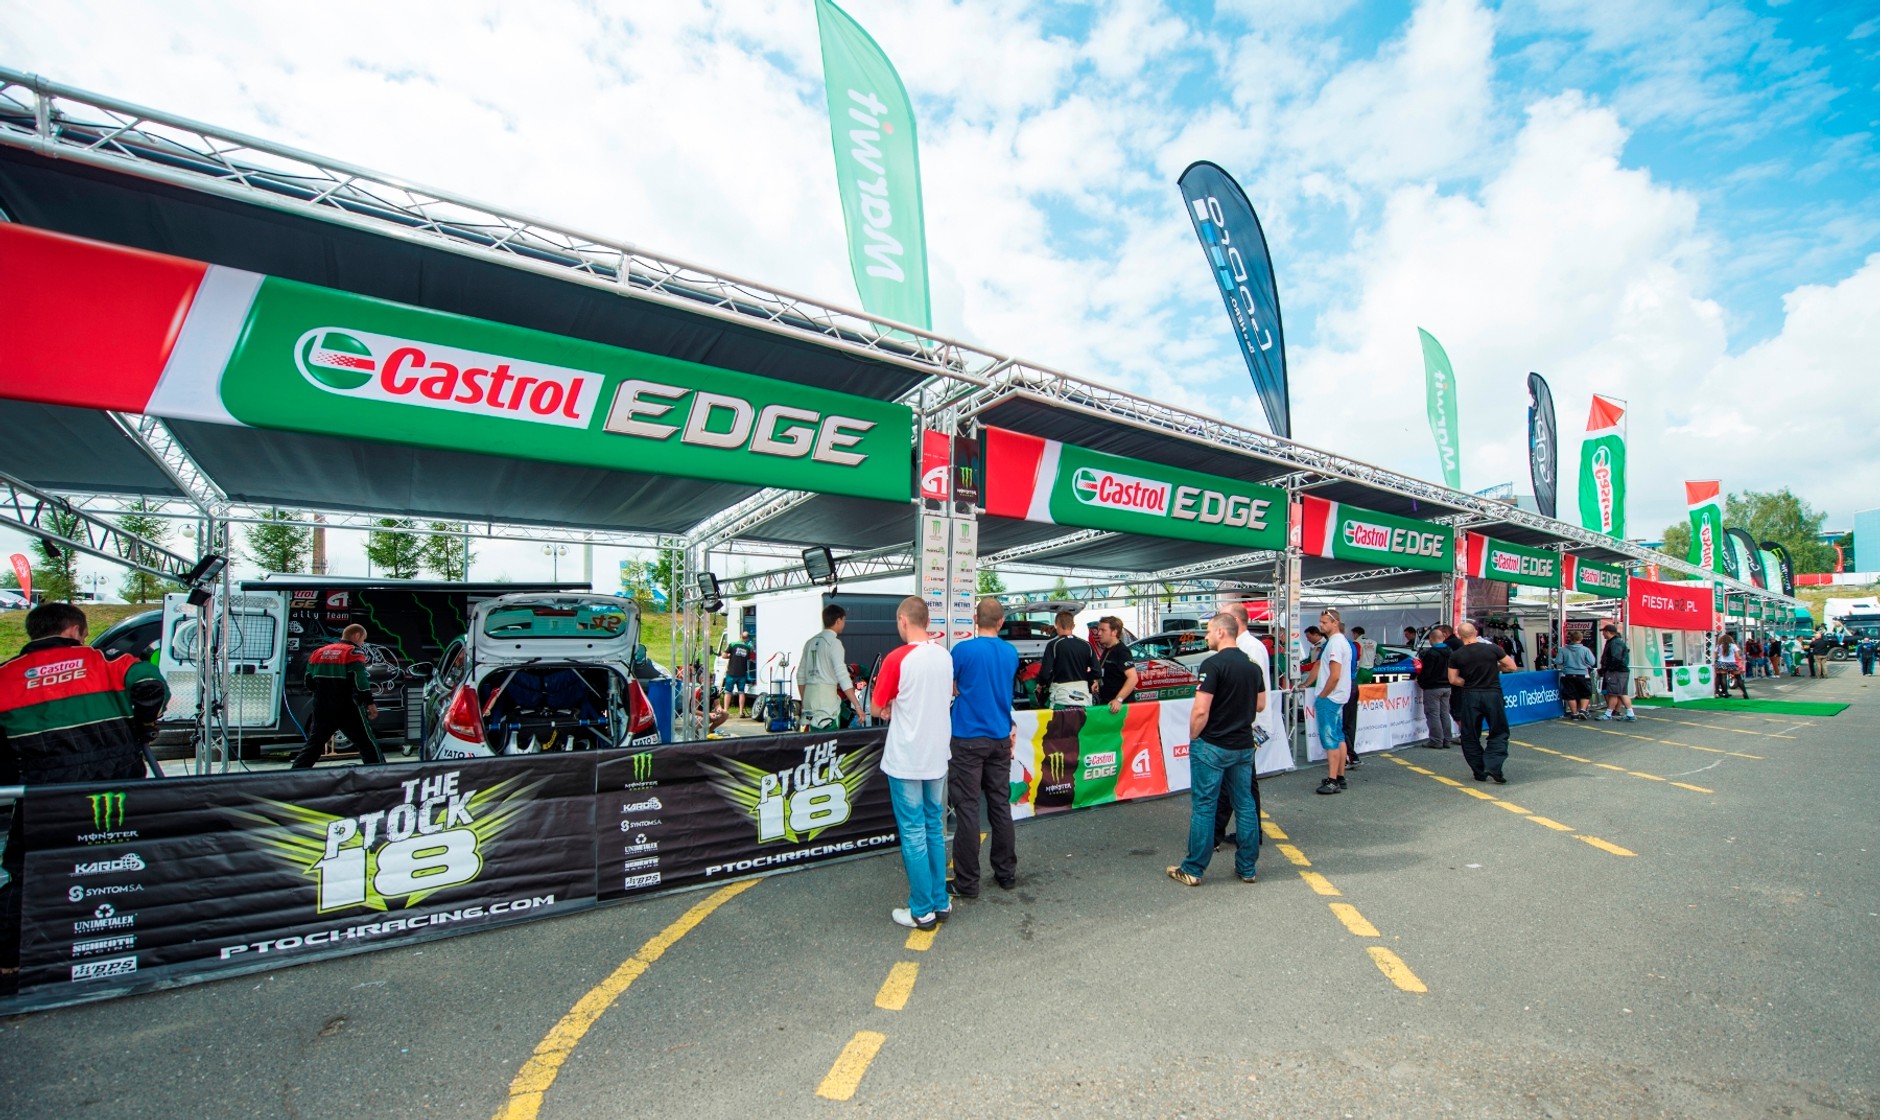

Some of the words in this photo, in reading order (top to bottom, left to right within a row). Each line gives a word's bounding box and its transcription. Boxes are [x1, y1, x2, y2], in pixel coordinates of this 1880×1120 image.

[380, 347, 584, 419] Castrol
[603, 378, 878, 467] EDGE
[1099, 476, 1165, 511] Castrol
[1171, 485, 1273, 531] EDGE
[1354, 524, 1389, 548] Castrol
[1391, 528, 1446, 558] EDGE
[1498, 553, 1520, 571] Castrol
[1521, 556, 1554, 577] EDGE
[1600, 571, 1622, 589] EDGE
[290, 600, 319, 609] GE
[292, 610, 319, 620] ally
[40, 659, 80, 675] Castrol
[26, 668, 87, 689] EDGE
[1160, 688, 1190, 698] EDGE
[444, 749, 465, 759] YATO
[804, 739, 838, 763] THE
[1091, 753, 1114, 765] Castrol
[760, 753, 847, 804] PTOCK
[1084, 765, 1118, 781] EDGE
[401, 770, 460, 803] THE
[755, 783, 850, 841] 18
[323, 789, 478, 860] PTOCK
[77, 830, 139, 842] MONSTER
[313, 828, 481, 911] 18
[86, 886, 128, 897] SYNTOM
[74, 915, 134, 930] UNIMETALEX
